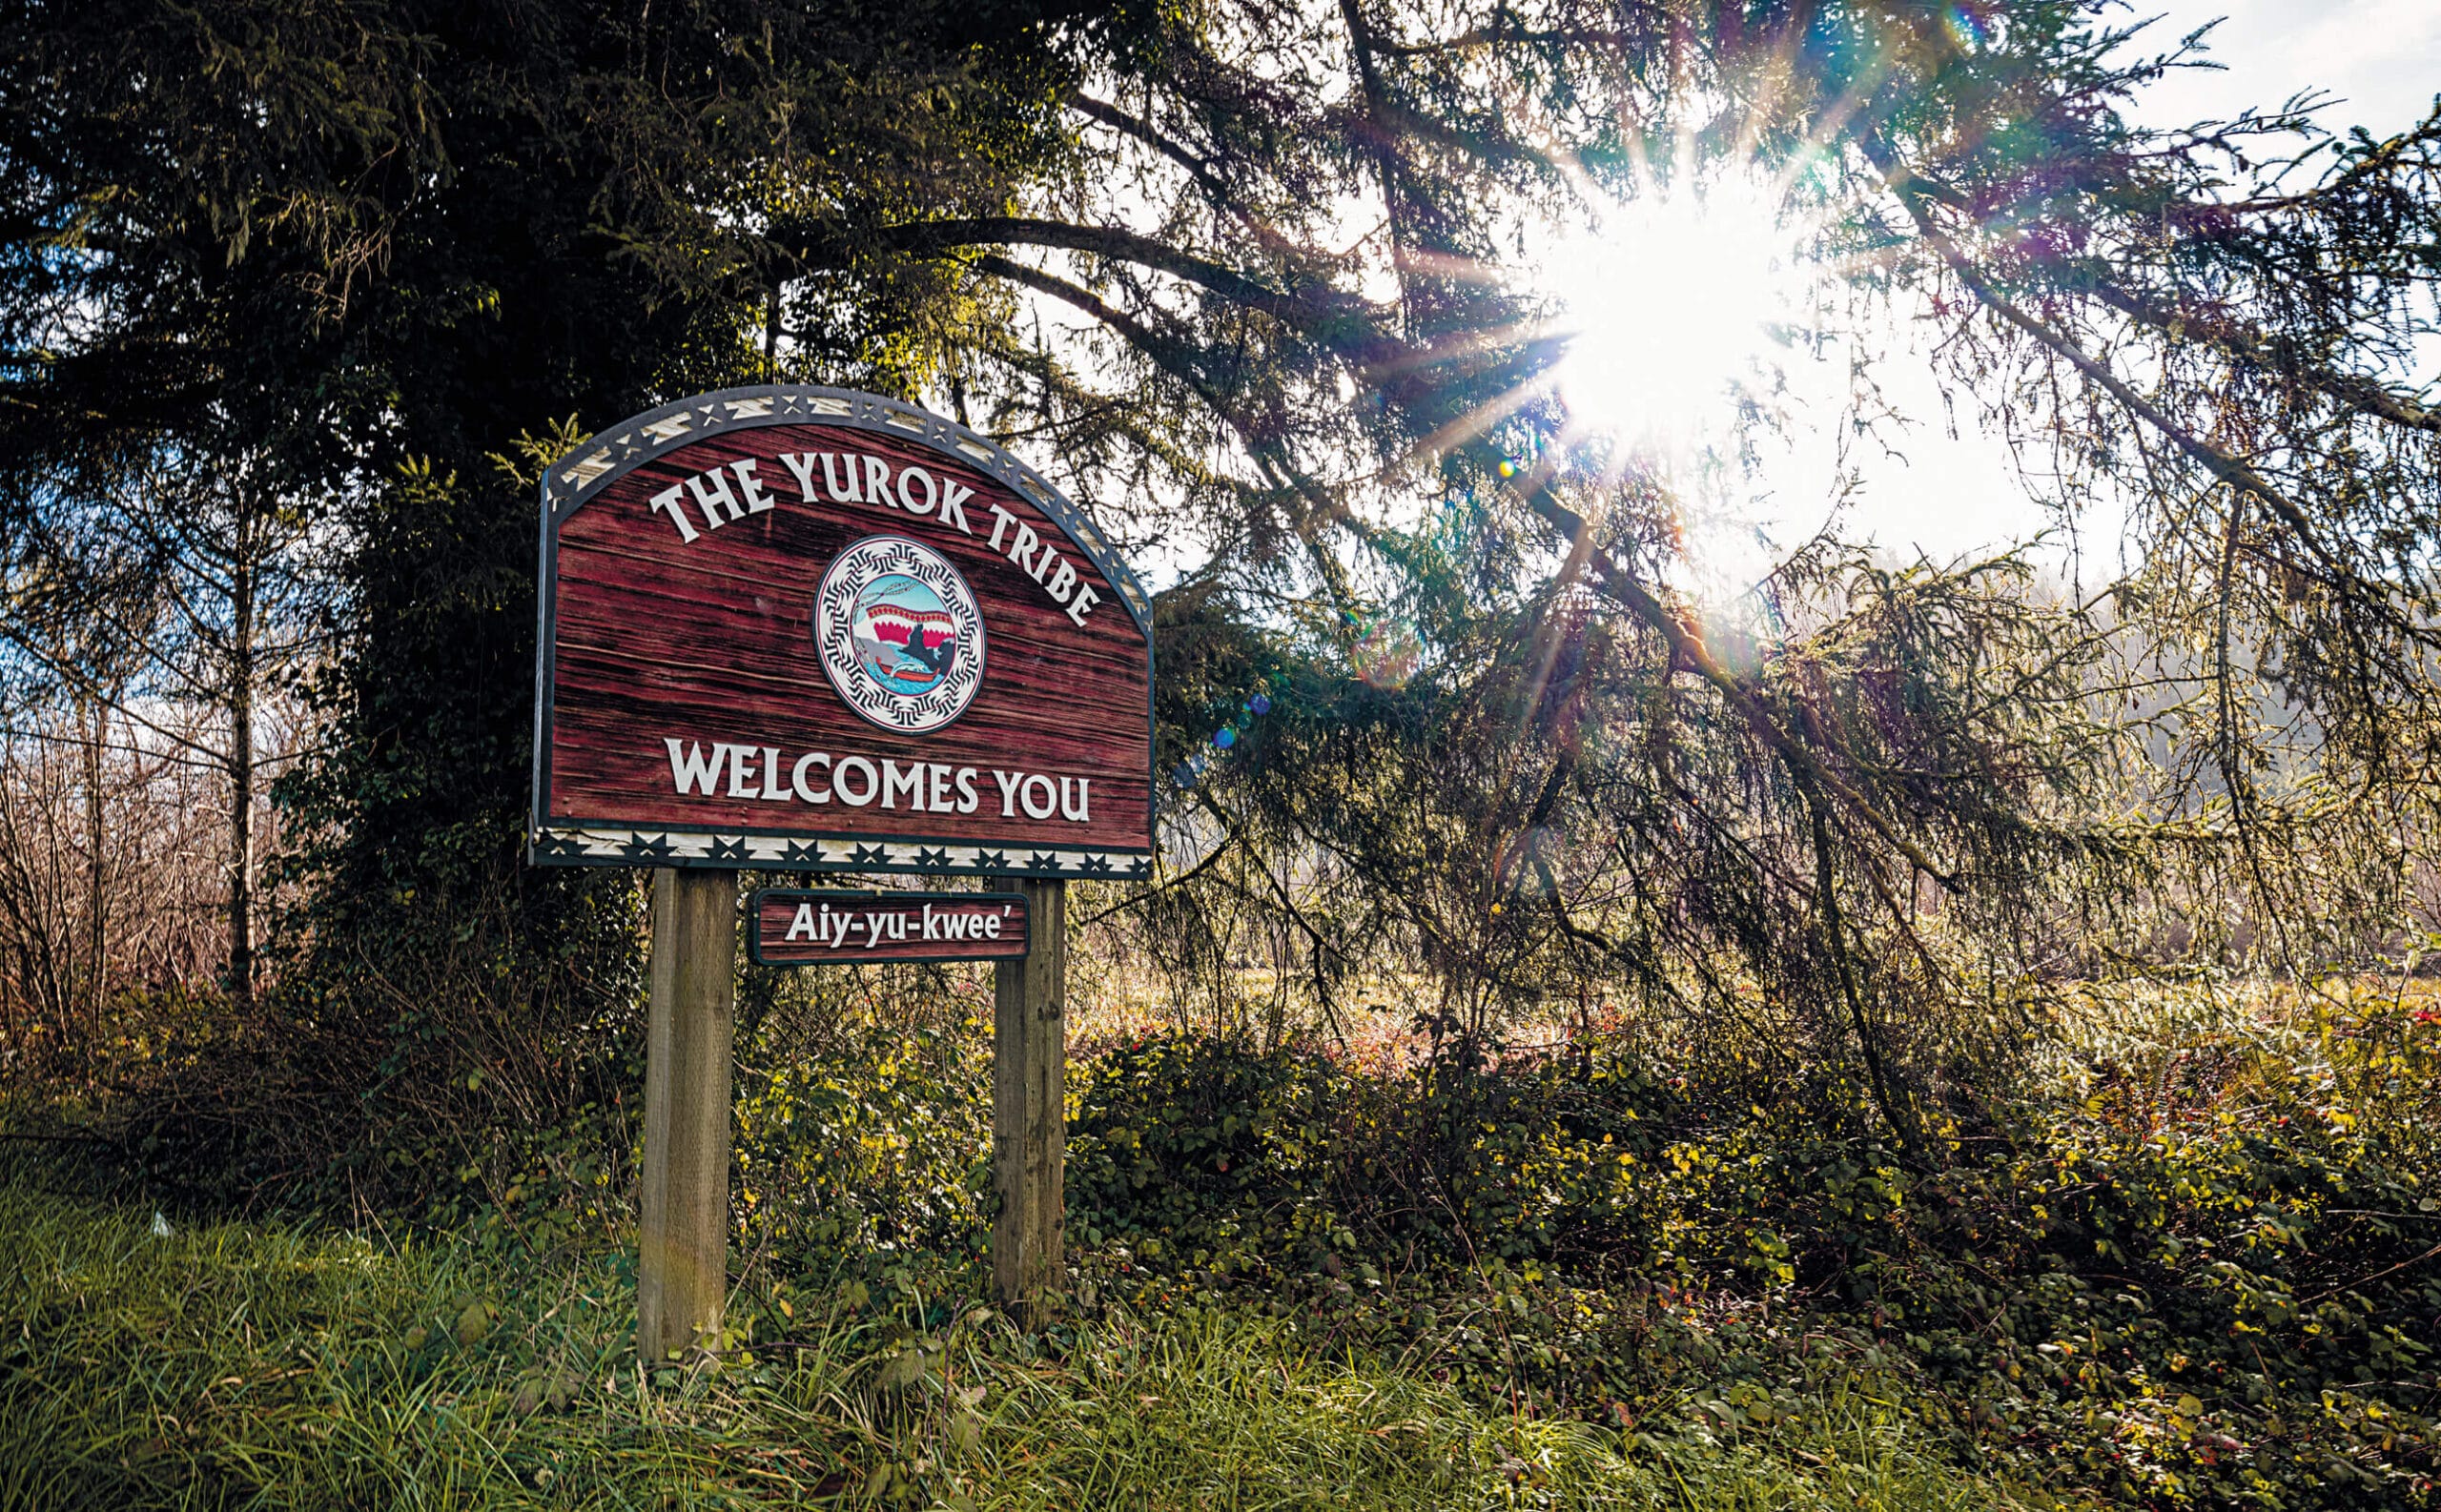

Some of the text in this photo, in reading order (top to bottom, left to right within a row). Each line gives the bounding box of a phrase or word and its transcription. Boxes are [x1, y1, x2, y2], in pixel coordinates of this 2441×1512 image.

[648, 452, 1101, 627] THE YUROK TRIBE
[664, 737, 1091, 823] WELCOMES YOU
